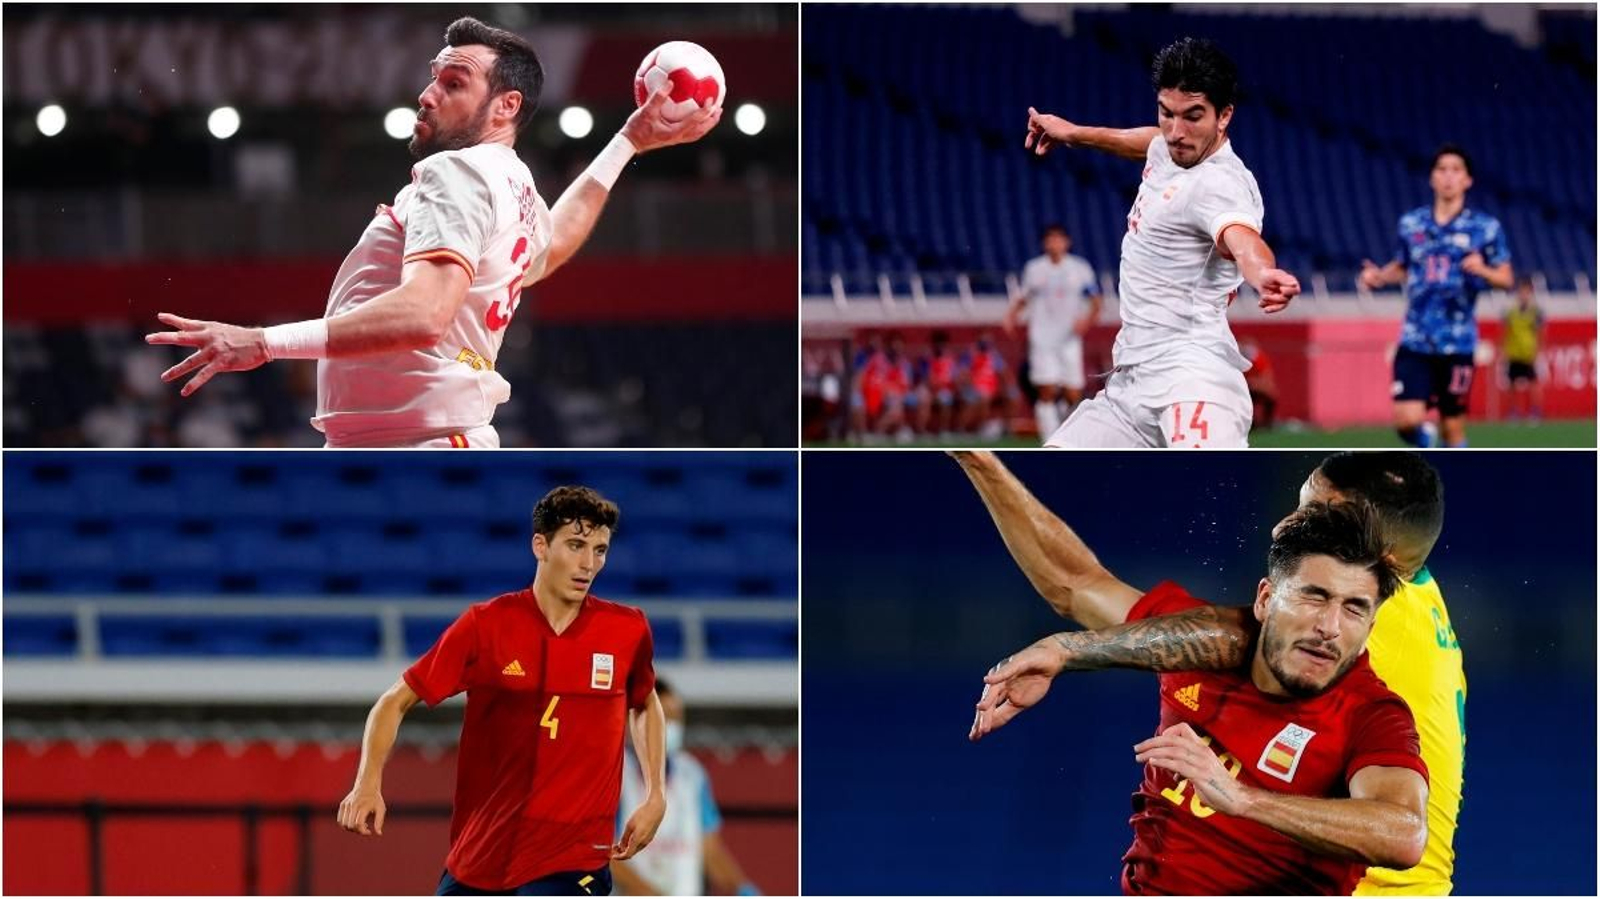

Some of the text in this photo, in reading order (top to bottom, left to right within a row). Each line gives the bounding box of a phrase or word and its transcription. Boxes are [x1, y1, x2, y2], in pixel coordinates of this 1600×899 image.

[1171, 400, 1208, 443] 14
[539, 695, 560, 740] 4
[1173, 690, 1200, 712] adidas
